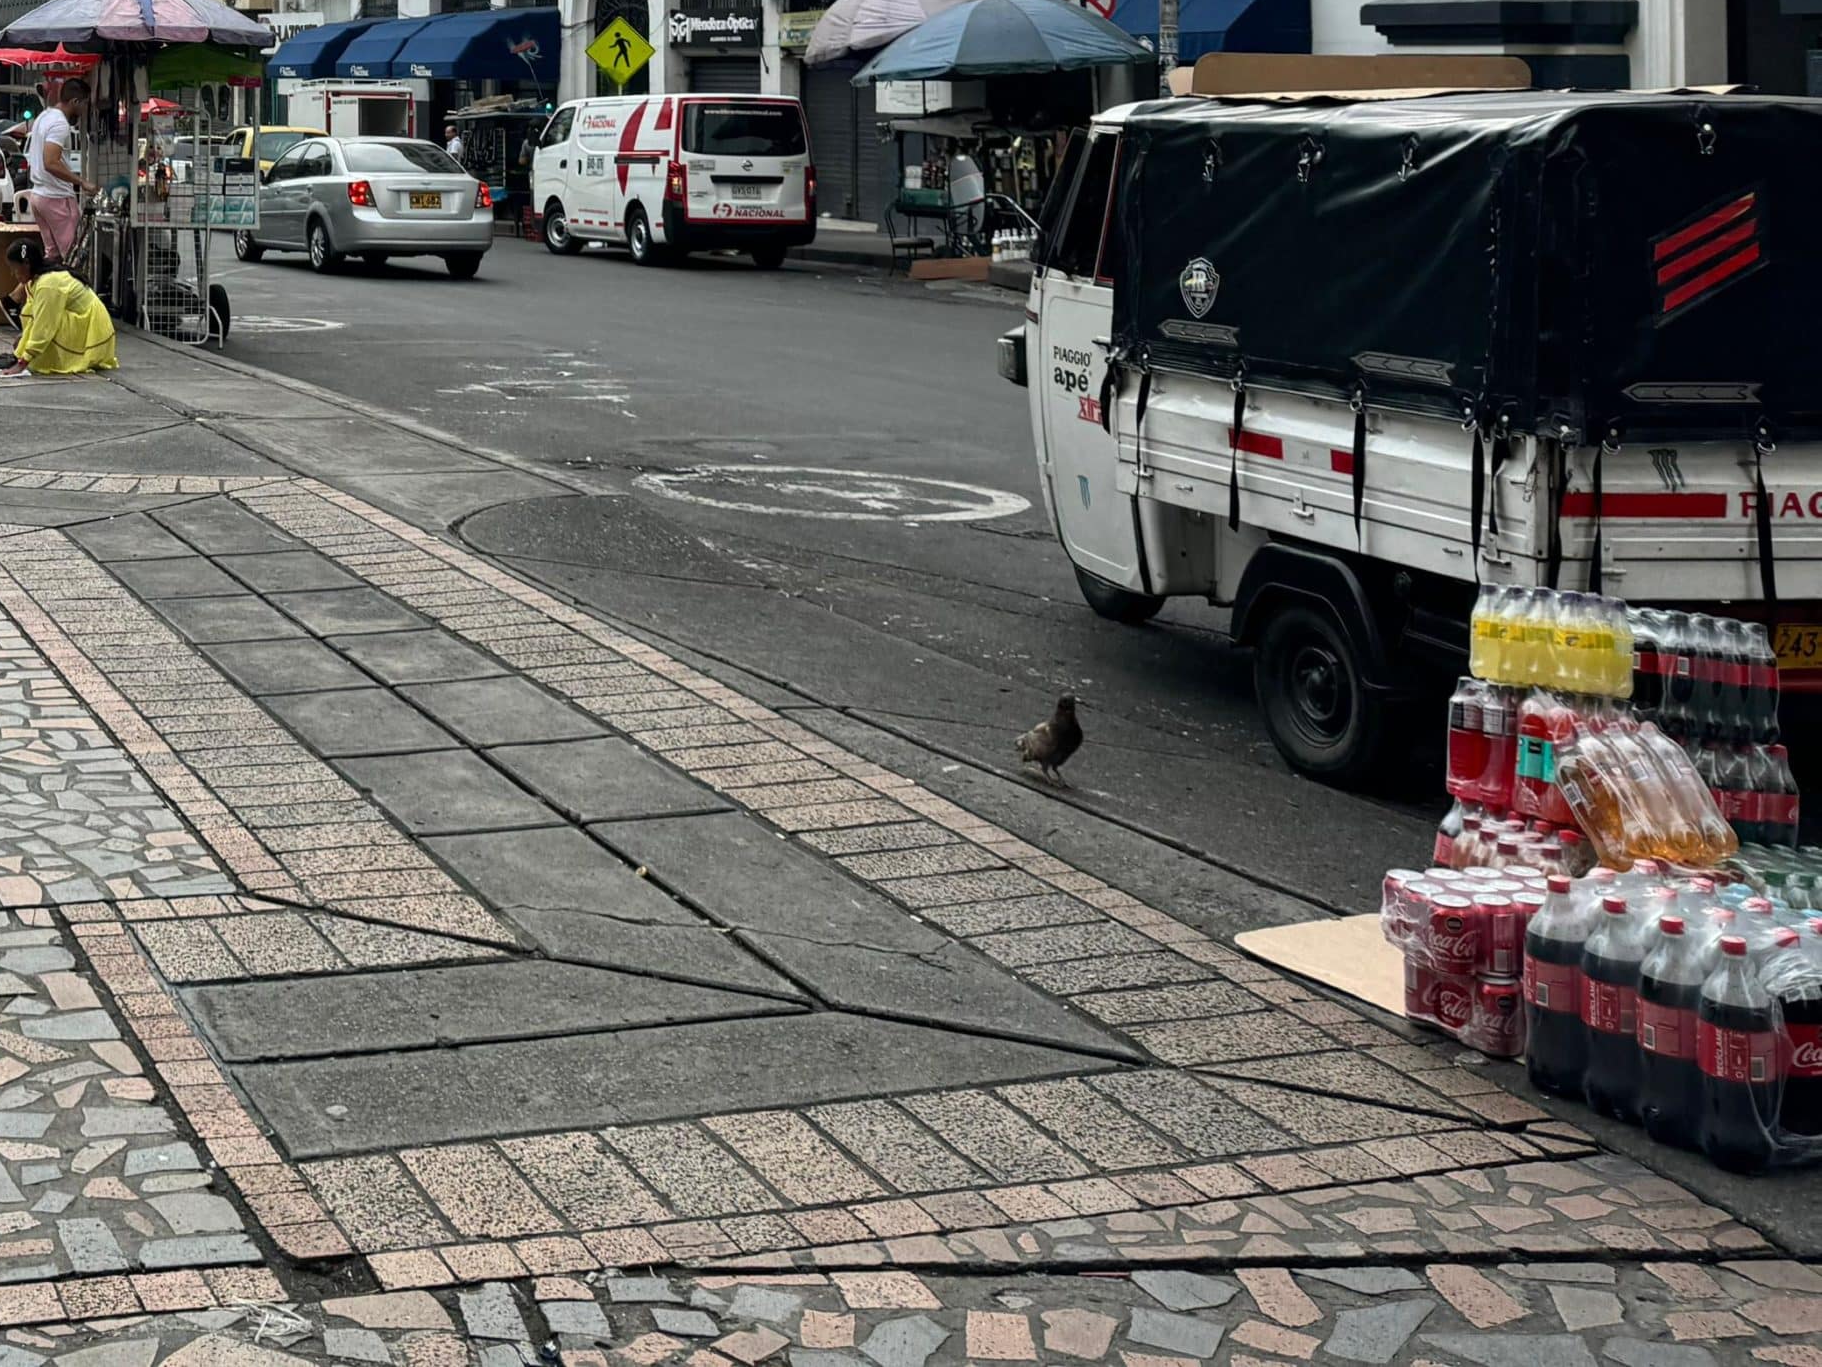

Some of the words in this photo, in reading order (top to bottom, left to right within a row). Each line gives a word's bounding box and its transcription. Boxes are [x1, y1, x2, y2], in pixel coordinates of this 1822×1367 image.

[691, 16, 726, 31] Mendoza
[727, 13, 755, 34] Óptica
[734, 209, 786, 218] NACIONAL
[1053, 346, 1091, 367] PIAGGIO
[1776, 631, 1818, 657] 243
